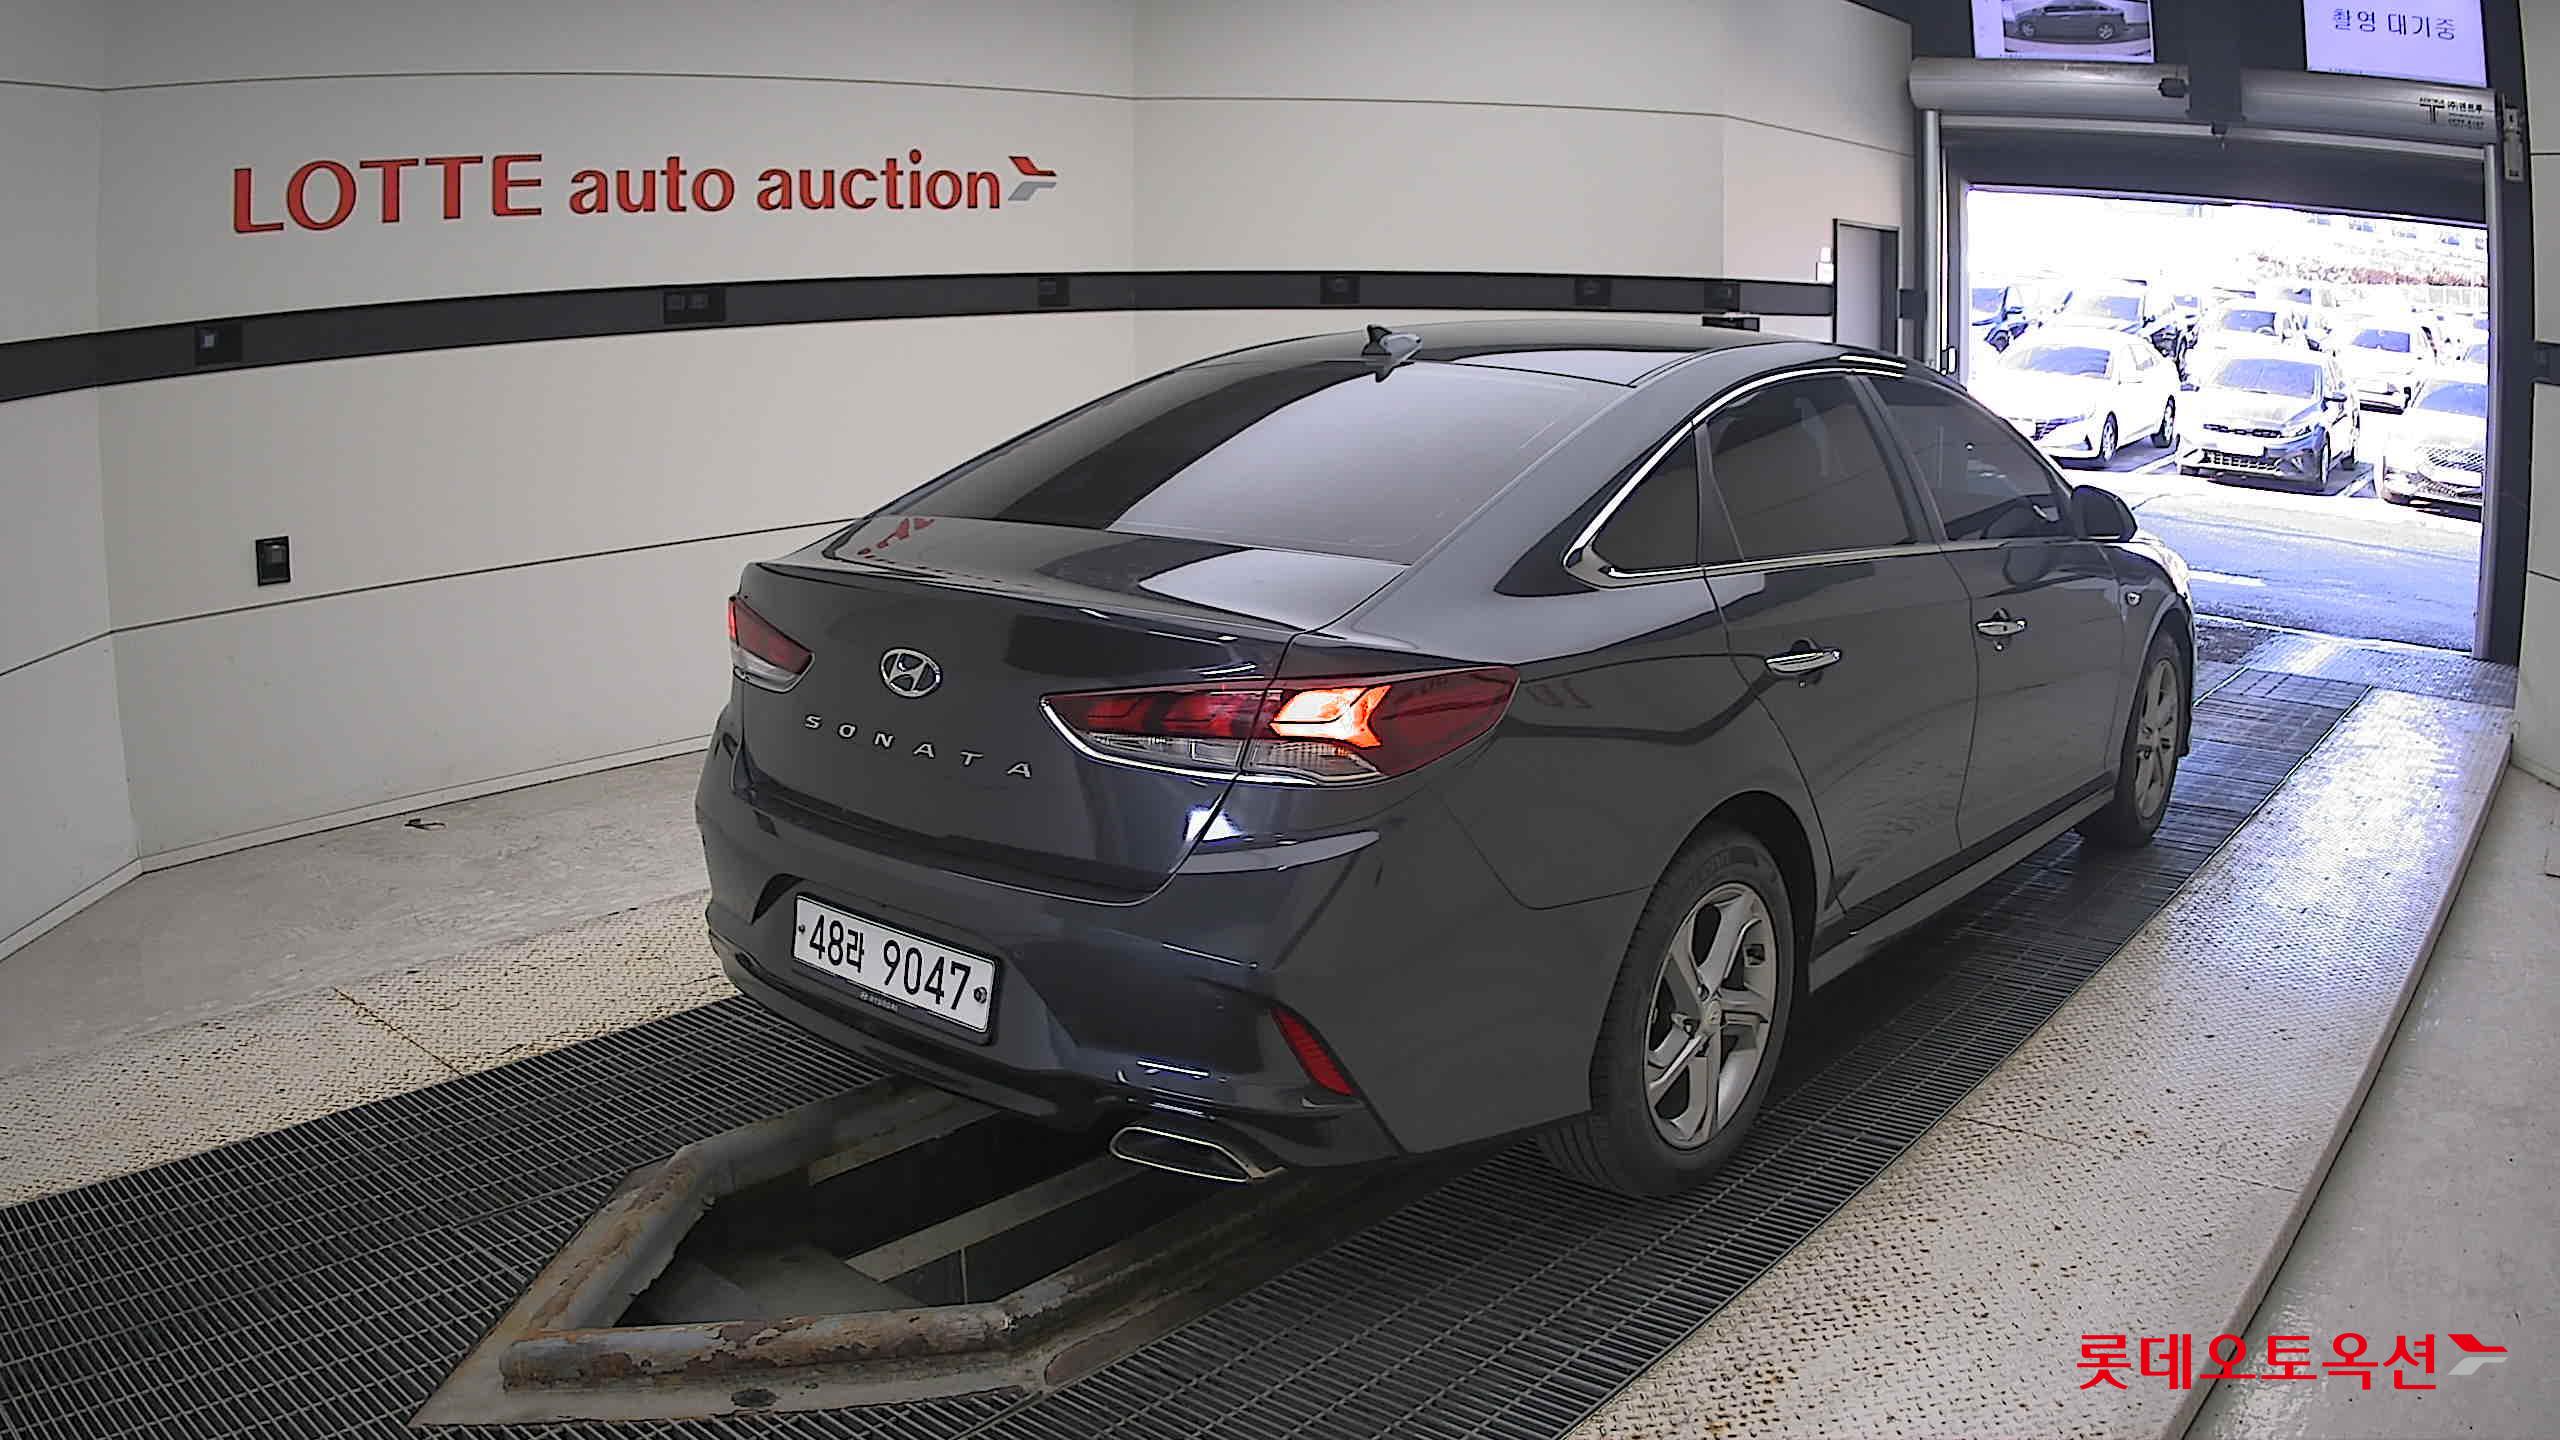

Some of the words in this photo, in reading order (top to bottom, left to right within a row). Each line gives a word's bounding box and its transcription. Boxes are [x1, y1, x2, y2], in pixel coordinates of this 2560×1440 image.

[2333, 8, 2376, 33] 촬영
[2387, 13, 2457, 41] 대기중
[233, 153, 543, 234] LOTTE
[568, 156, 736, 214] auto
[756, 149, 1001, 211] auction
[803, 712, 1034, 779] SONATA
[809, 914, 865, 971] 48라
[883, 937, 972, 1012] 9047
